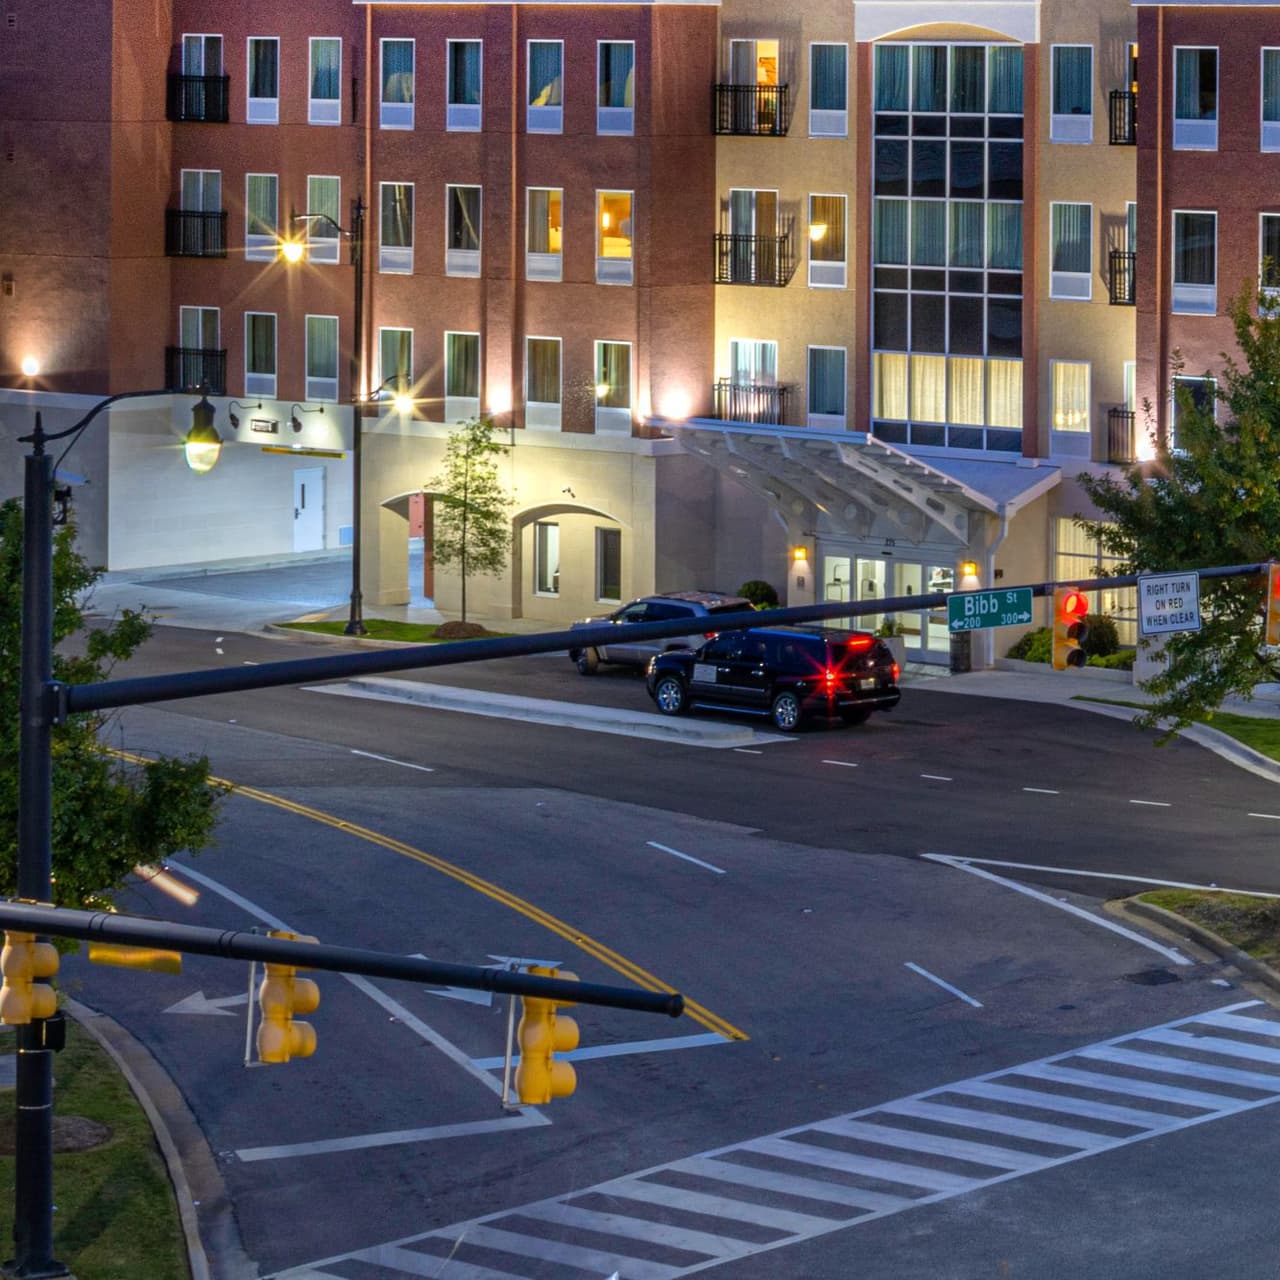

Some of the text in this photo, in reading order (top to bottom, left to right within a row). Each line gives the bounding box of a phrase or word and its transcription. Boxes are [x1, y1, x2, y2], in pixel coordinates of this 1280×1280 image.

[1147, 582, 1191, 596] RIGHT TURN
[964, 592, 1017, 616] Bibb St
[1156, 597, 1184, 610] ON RED
[963, 616, 981, 629] 200
[1001, 613, 1018, 625] 300
[1146, 611, 1194, 627] WHEN CLEAR
